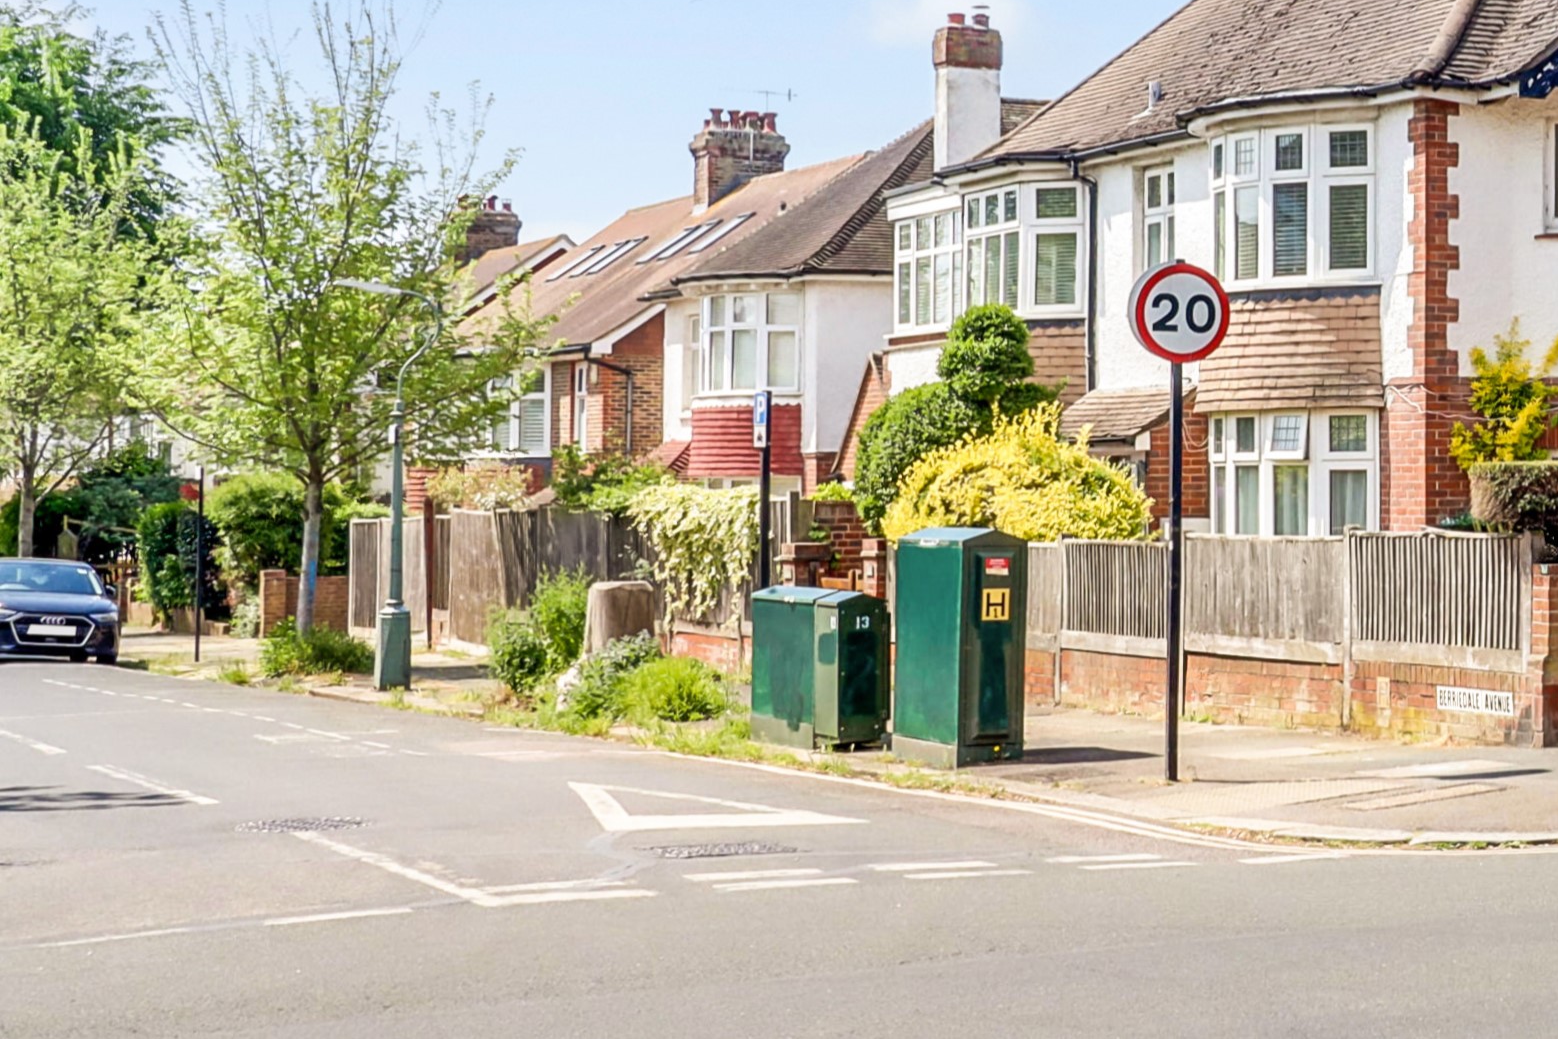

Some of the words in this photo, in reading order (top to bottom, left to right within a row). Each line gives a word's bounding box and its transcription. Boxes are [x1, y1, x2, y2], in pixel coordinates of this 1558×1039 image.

[1151, 293, 1216, 334] 20
[756, 395, 766, 424] P
[986, 592, 1005, 617] H
[855, 615, 870, 630] 13
[1439, 689, 1480, 710] BERRIEDALE
[1485, 693, 1511, 713] AVENUE
